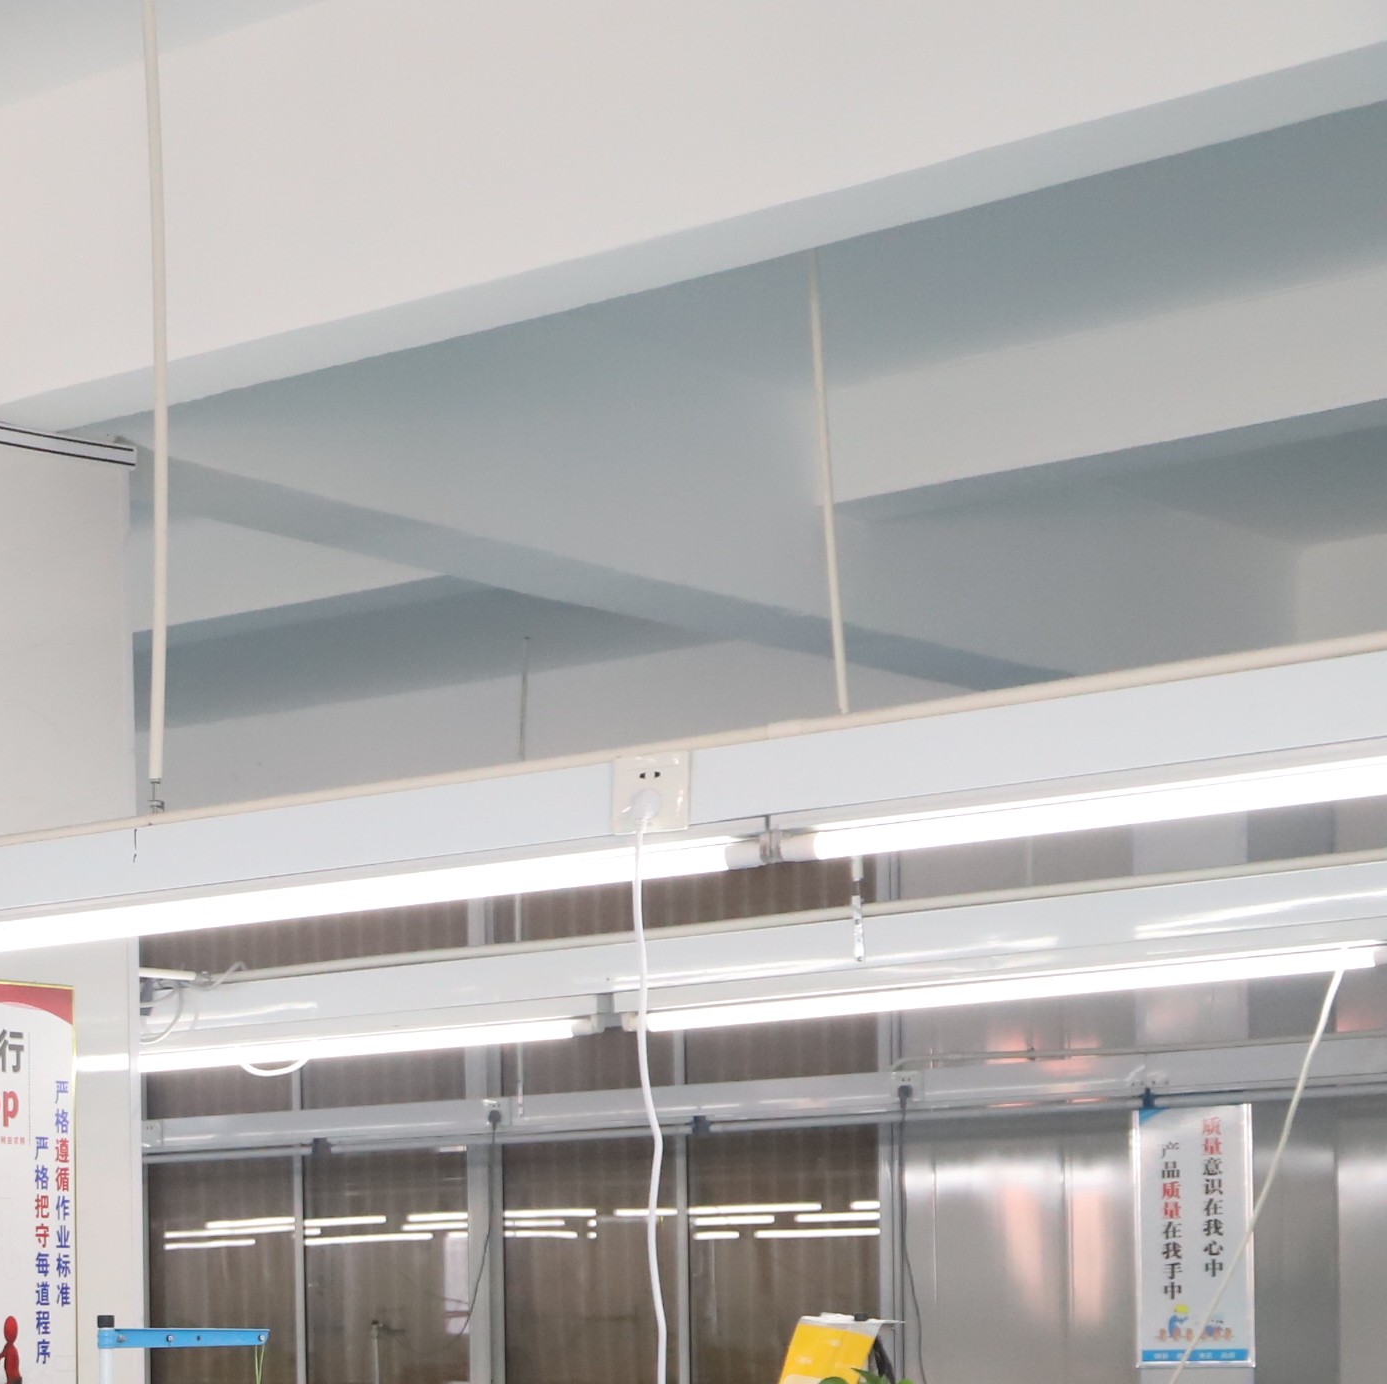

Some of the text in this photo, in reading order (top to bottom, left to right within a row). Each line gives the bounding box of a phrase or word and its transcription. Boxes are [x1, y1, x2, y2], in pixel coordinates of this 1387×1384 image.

[34, 1136, 51, 1365] 严格把守每道程序
[55, 1080, 71, 1307] 严格遵循作业标准
[1161, 1141, 1183, 1300] 产品质量在我手中
[1202, 1117, 1224, 1278] 质量意识在我心中
